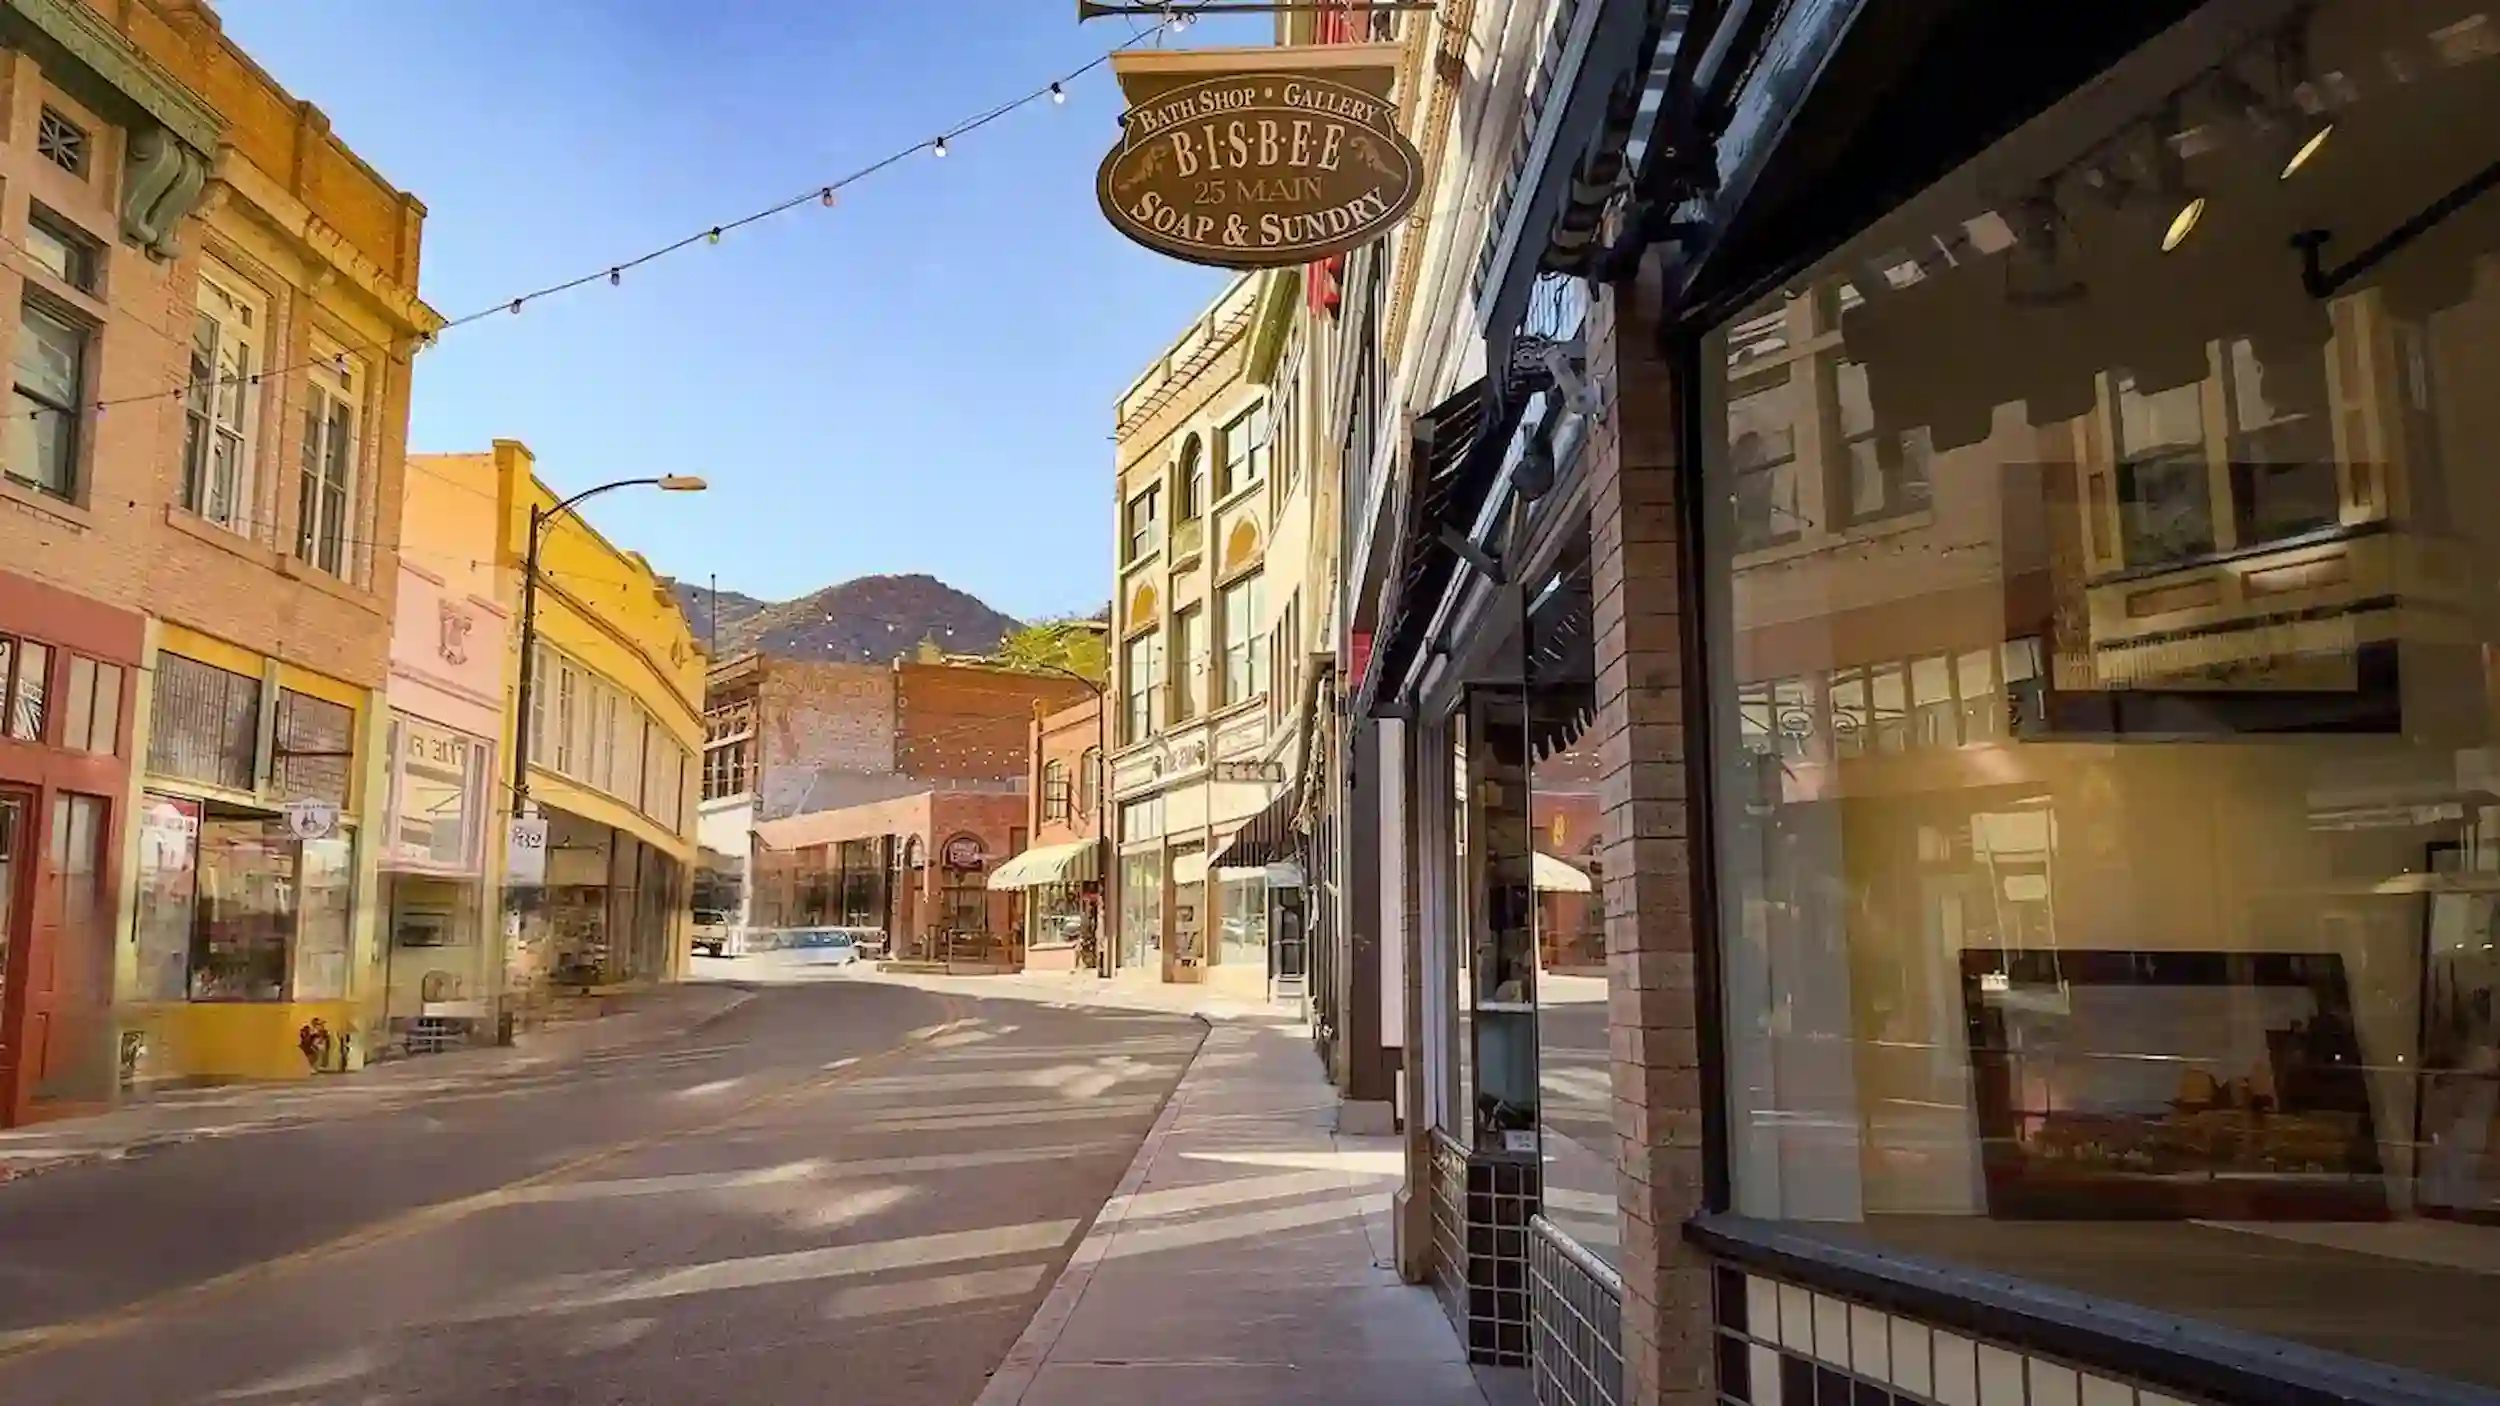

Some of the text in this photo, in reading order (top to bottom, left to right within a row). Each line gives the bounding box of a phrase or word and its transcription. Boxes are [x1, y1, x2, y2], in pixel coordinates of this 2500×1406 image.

[1136, 83, 1379, 134] BATH SHOP GALLERY
[1129, 185, 1389, 247] SOAP & SUNDRY
[1193, 176, 1322, 205] 25 MAIN
